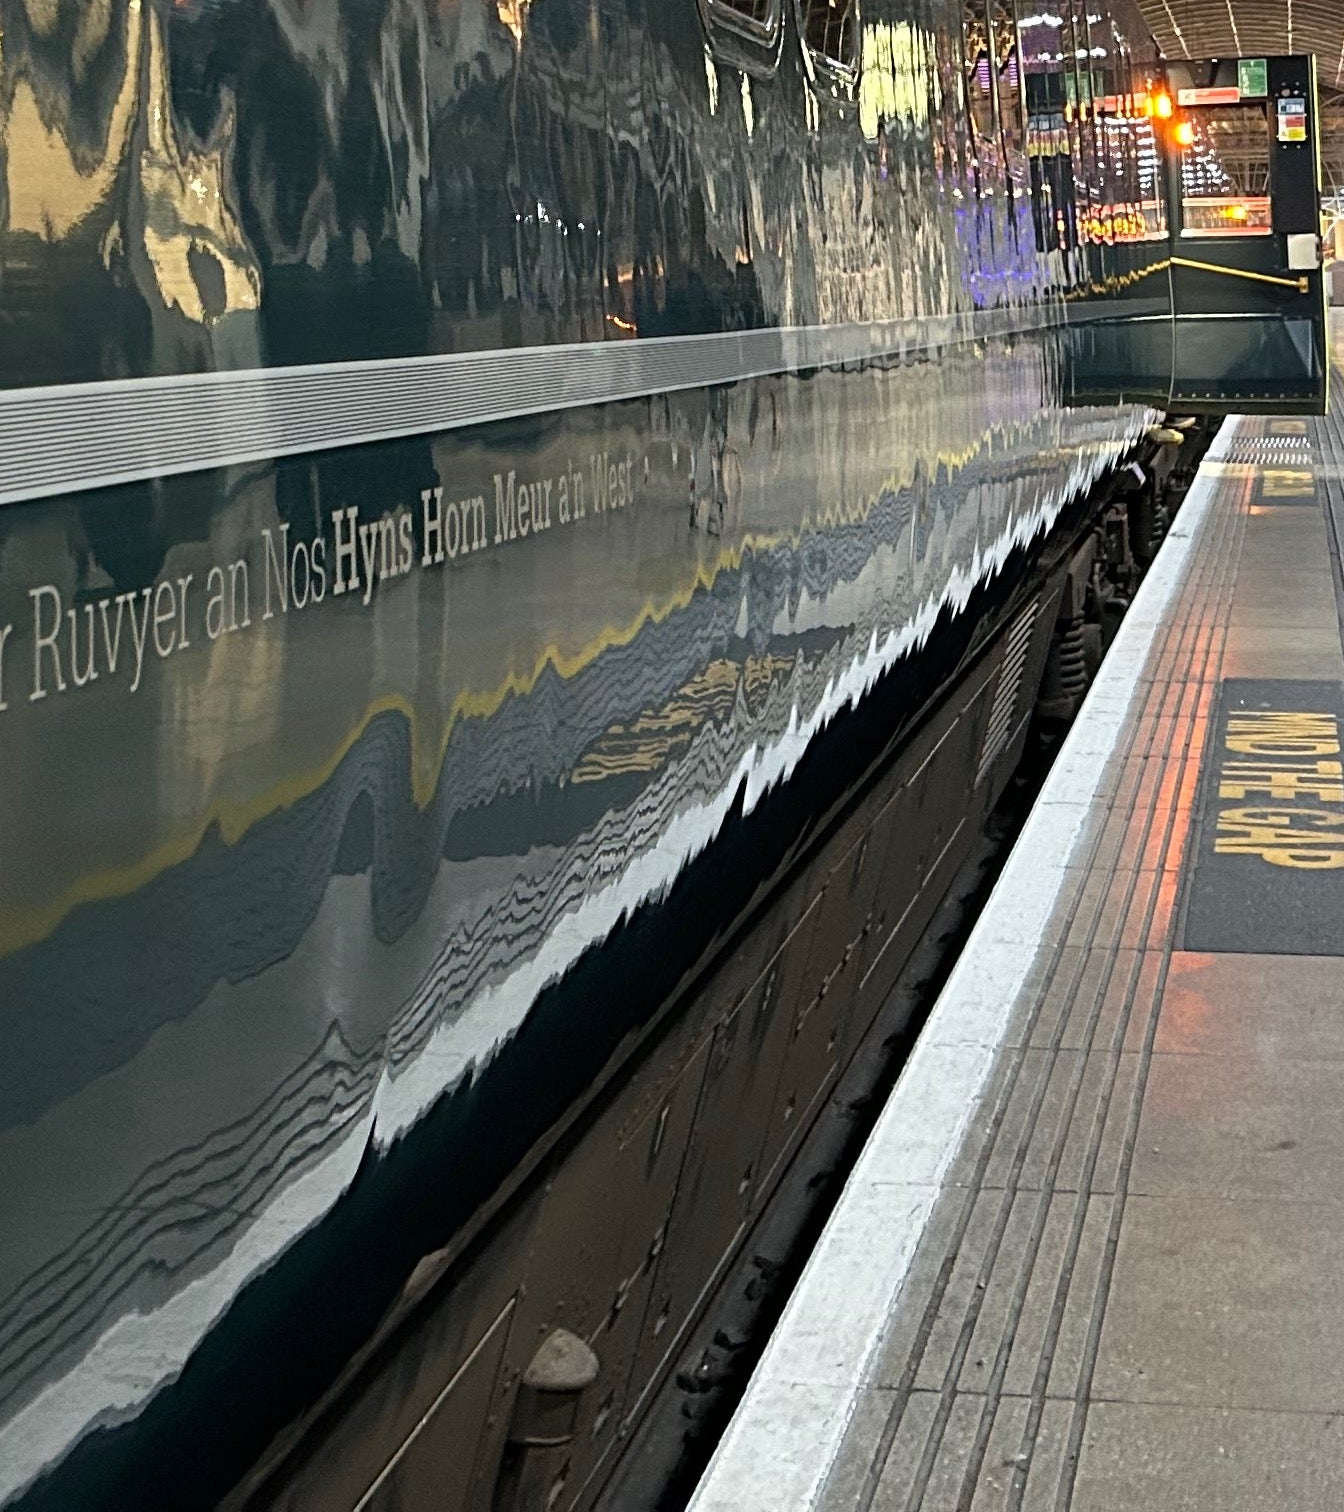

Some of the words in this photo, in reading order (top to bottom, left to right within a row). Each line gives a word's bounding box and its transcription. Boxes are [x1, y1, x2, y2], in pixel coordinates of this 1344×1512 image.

[27, 574, 196, 703] Ruvyer
[204, 556, 252, 641] an
[261, 521, 326, 622] Nos
[331, 505, 414, 606] Hyns
[420, 486, 488, 568] Horn
[493, 469, 553, 545] Meur
[558, 458, 585, 525] a'n
[590, 451, 634, 515] West
[1224, 710, 1342, 756] MIND
